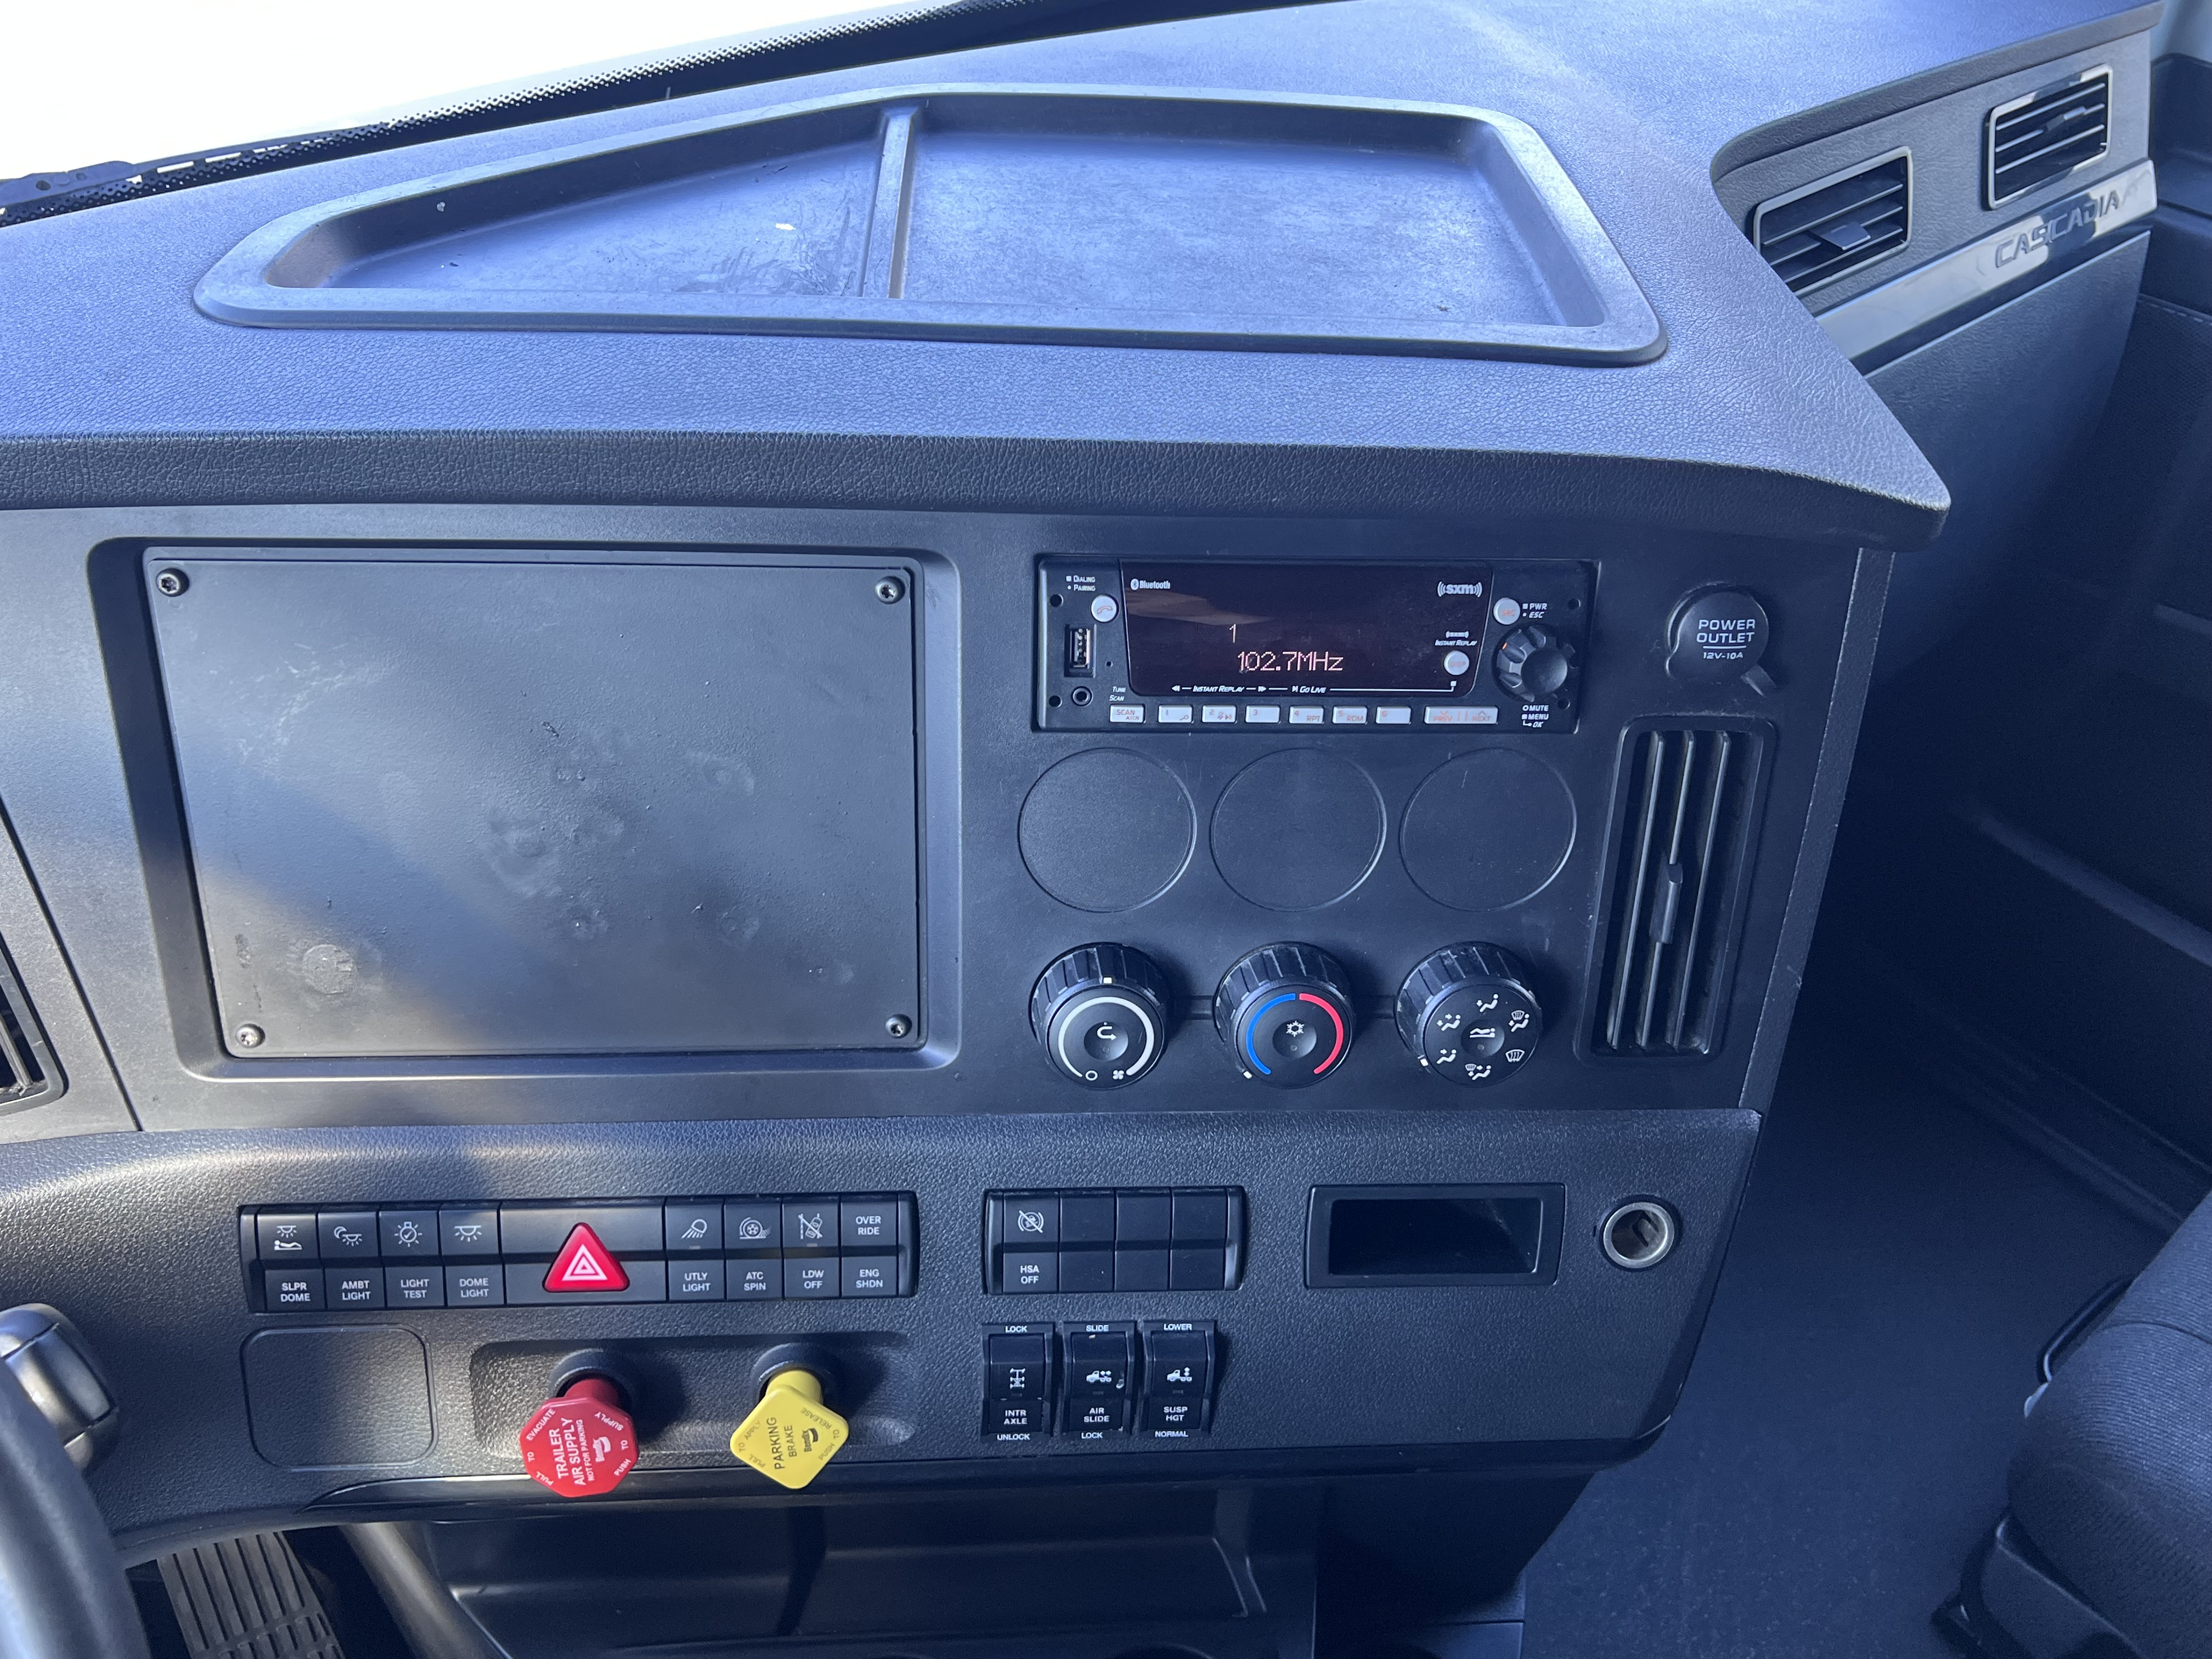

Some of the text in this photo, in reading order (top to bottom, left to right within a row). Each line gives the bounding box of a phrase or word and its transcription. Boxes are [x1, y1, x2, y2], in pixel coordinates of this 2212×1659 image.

[1996, 190, 2120, 268] CASCADIA
[1139, 580, 1171, 589] Bluetooth
[1698, 619, 1756, 630] POWER
[1229, 624, 1236, 644] 1
[1696, 631, 1755, 644] OUTLET
[1238, 651, 1344, 671] 102.7MHz
[855, 1215, 882, 1225] OVER
[857, 1226, 881, 1235] RIDE
[802, 1269, 824, 1279] LDW
[859, 1268, 879, 1278] ENG
[1020, 1265, 1040, 1274] HSA
[684, 1271, 708, 1282] UTLY
[746, 1271, 764, 1281] ATC
[1020, 1276, 1039, 1284] OFF
[281, 1281, 307, 1291] SLPR
[341, 1280, 370, 1290] AMBT
[400, 1278, 430, 1289] LIGHT
[459, 1278, 489, 1288] DOME
[682, 1282, 712, 1292] LIGHT
[743, 1281, 766, 1291] SPIN
[804, 1280, 823, 1290] OFF
[855, 1279, 883, 1288] SHDN
[280, 1292, 311, 1302] DOME
[342, 1290, 371, 1300] LIGHT
[403, 1289, 427, 1299] TEST
[460, 1288, 489, 1298] LIGHT
[1005, 1325, 1028, 1333] LOCK
[1086, 1324, 1109, 1332] SLIDE
[1163, 1323, 1193, 1331] LOWER
[1163, 1406, 1188, 1414] SUSP
[1003, 1417, 1028, 1425] AXLE
[1084, 1414, 1110, 1423] SLIDE
[1165, 1413, 1184, 1421] HGT
[800, 1407, 840, 1460] PUSH TO RELEASE
[997, 1432, 1030, 1441] UNLOCK
[1155, 1430, 1188, 1438] NORMAL
[594, 1412, 632, 1476] PUSH TO SUPPLY
[738, 1420, 766, 1469] PULL TO APPLY
[766, 1417, 785, 1470] PARKING
[783, 1424, 797, 1458] BRAKE
[526, 1408, 556, 1486] PULL TO EVACUATE
[561, 1418, 586, 1486] AIR SUPPLY
[576, 1419, 595, 1482] NOT FOR PARKING
[549, 1428, 569, 1479] TRAILER
